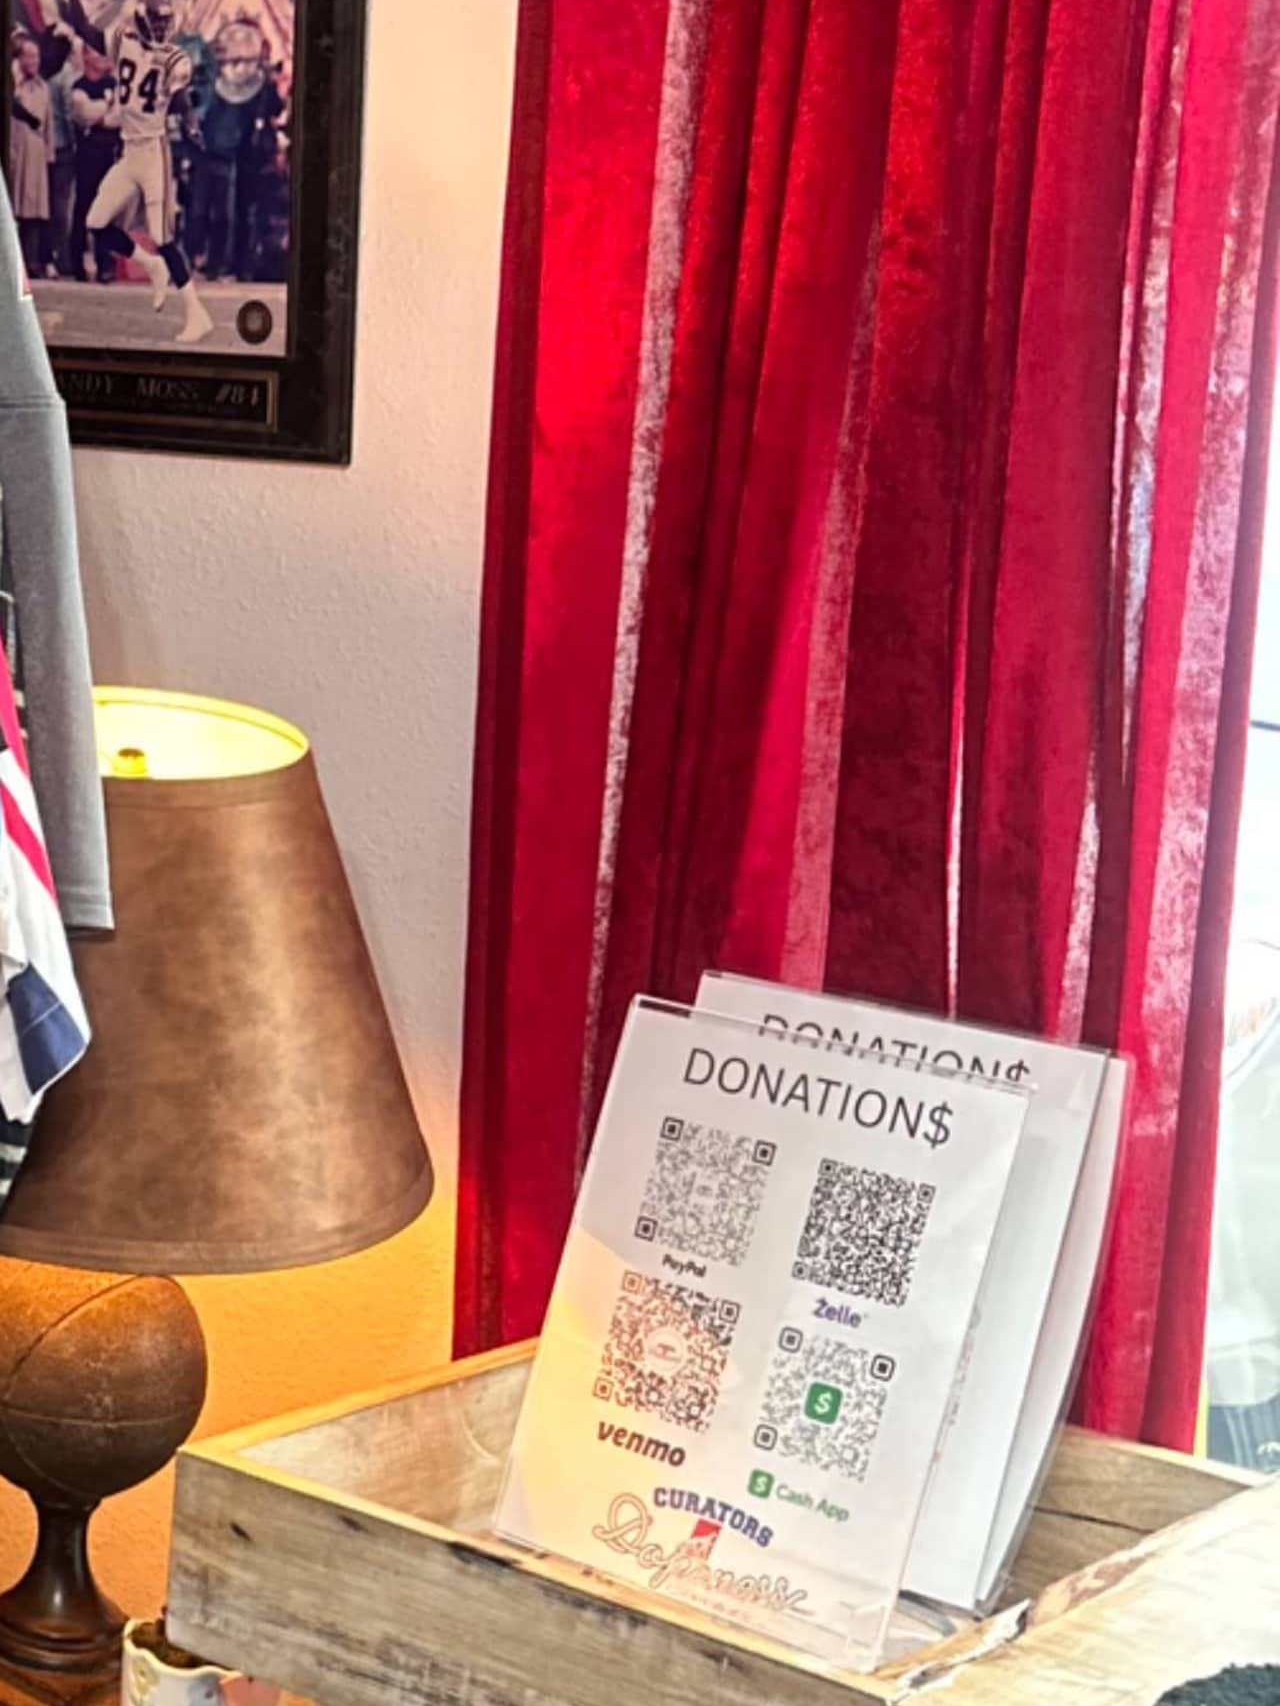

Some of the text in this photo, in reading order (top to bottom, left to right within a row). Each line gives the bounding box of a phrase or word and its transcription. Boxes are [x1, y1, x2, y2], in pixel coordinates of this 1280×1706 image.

[117, 56, 163, 114] 84
[684, 1048, 954, 1149] DONATION$
[662, 1253, 708, 1278] PayPal
[812, 1297, 862, 1329] Zelle
[597, 1420, 687, 1467] venmo
[654, 1486, 775, 1547] CURATORS
[776, 1483, 850, 1523] Cash App
